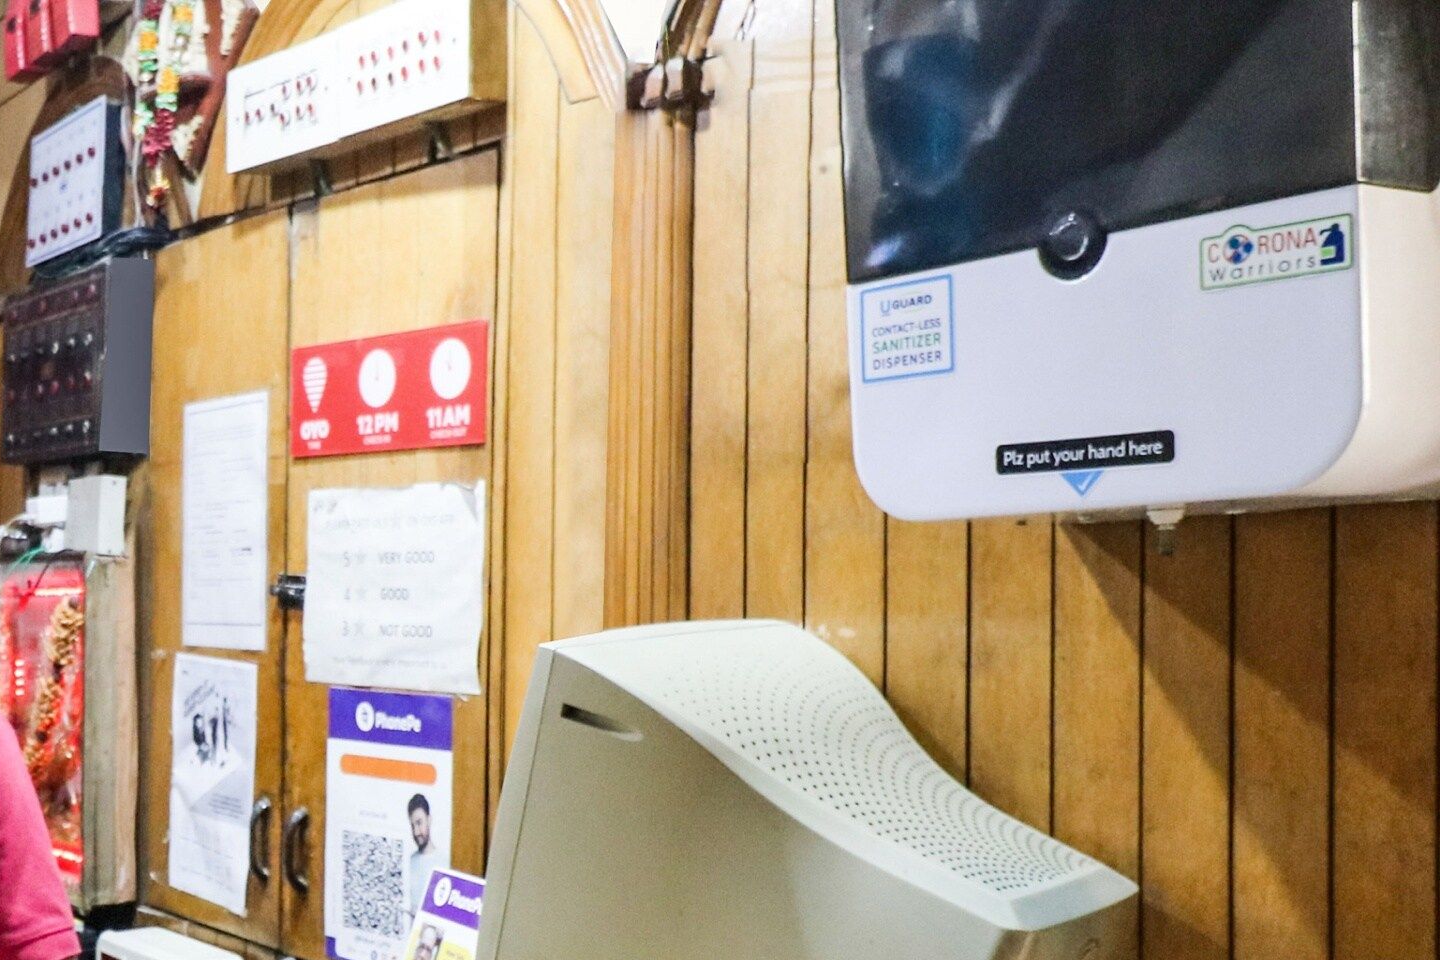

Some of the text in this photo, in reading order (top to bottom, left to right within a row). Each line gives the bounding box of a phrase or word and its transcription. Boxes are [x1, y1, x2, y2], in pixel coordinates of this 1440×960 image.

[872, 317, 942, 338] CONTACT-LESS
[872, 332, 942, 355] SANITIZER
[872, 350, 942, 371] DISPENSER
[1002, 439, 1164, 469] Plz put your hand here
[378, 552, 401, 565] VERY
[404, 551, 435, 565] GOOD
[380, 587, 410, 601] GOOD
[378, 624, 400, 637] NOT
[401, 623, 433, 638] GOOD
